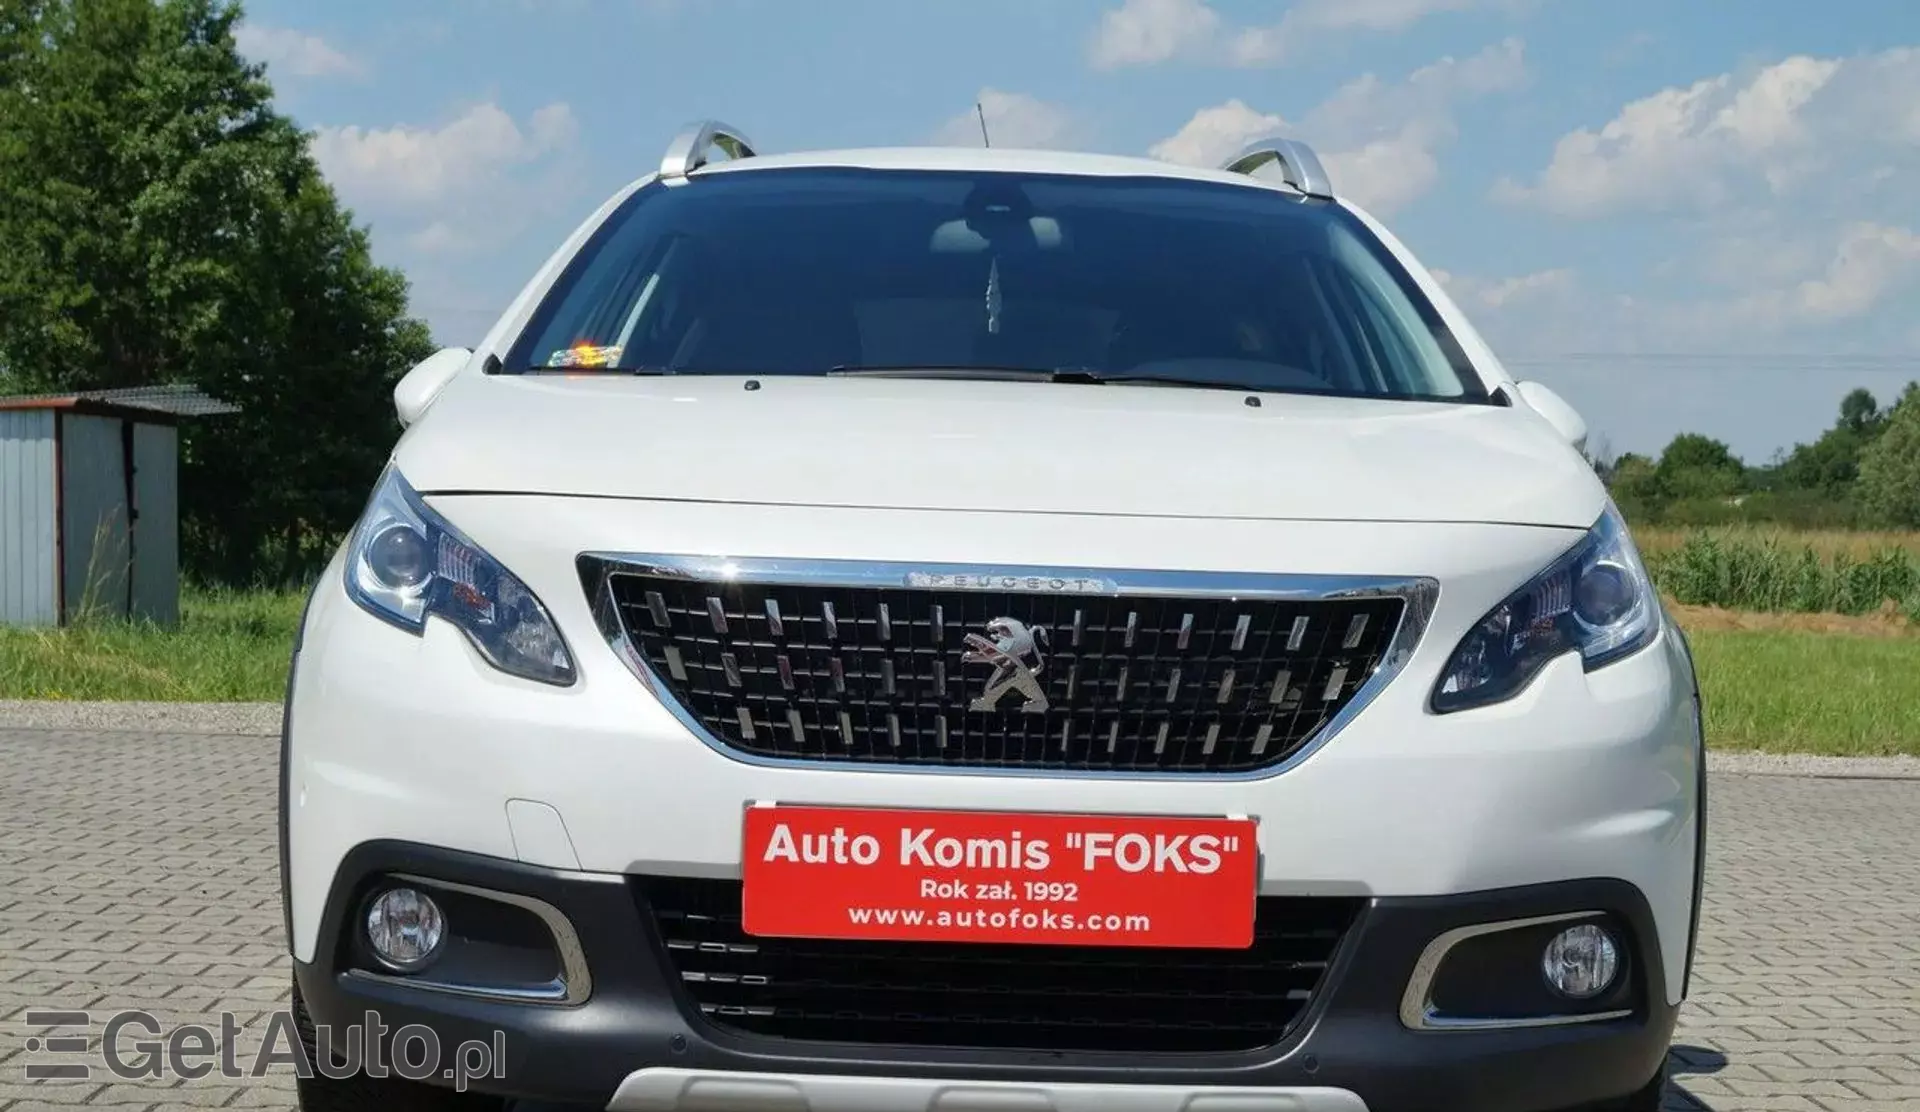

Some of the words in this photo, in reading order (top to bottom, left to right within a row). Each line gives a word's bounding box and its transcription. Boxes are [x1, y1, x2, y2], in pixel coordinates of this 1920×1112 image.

[929, 574, 1089, 590] PEUGEOT
[763, 823, 881, 866] Auto
[899, 827, 1051, 870] Komis
[1066, 832, 1239, 874] "FOKS"
[920, 879, 967, 899] Rok
[975, 880, 1017, 901] zał.
[1024, 881, 1078, 902] 1992
[848, 905, 1151, 932] www.autofoks.com
